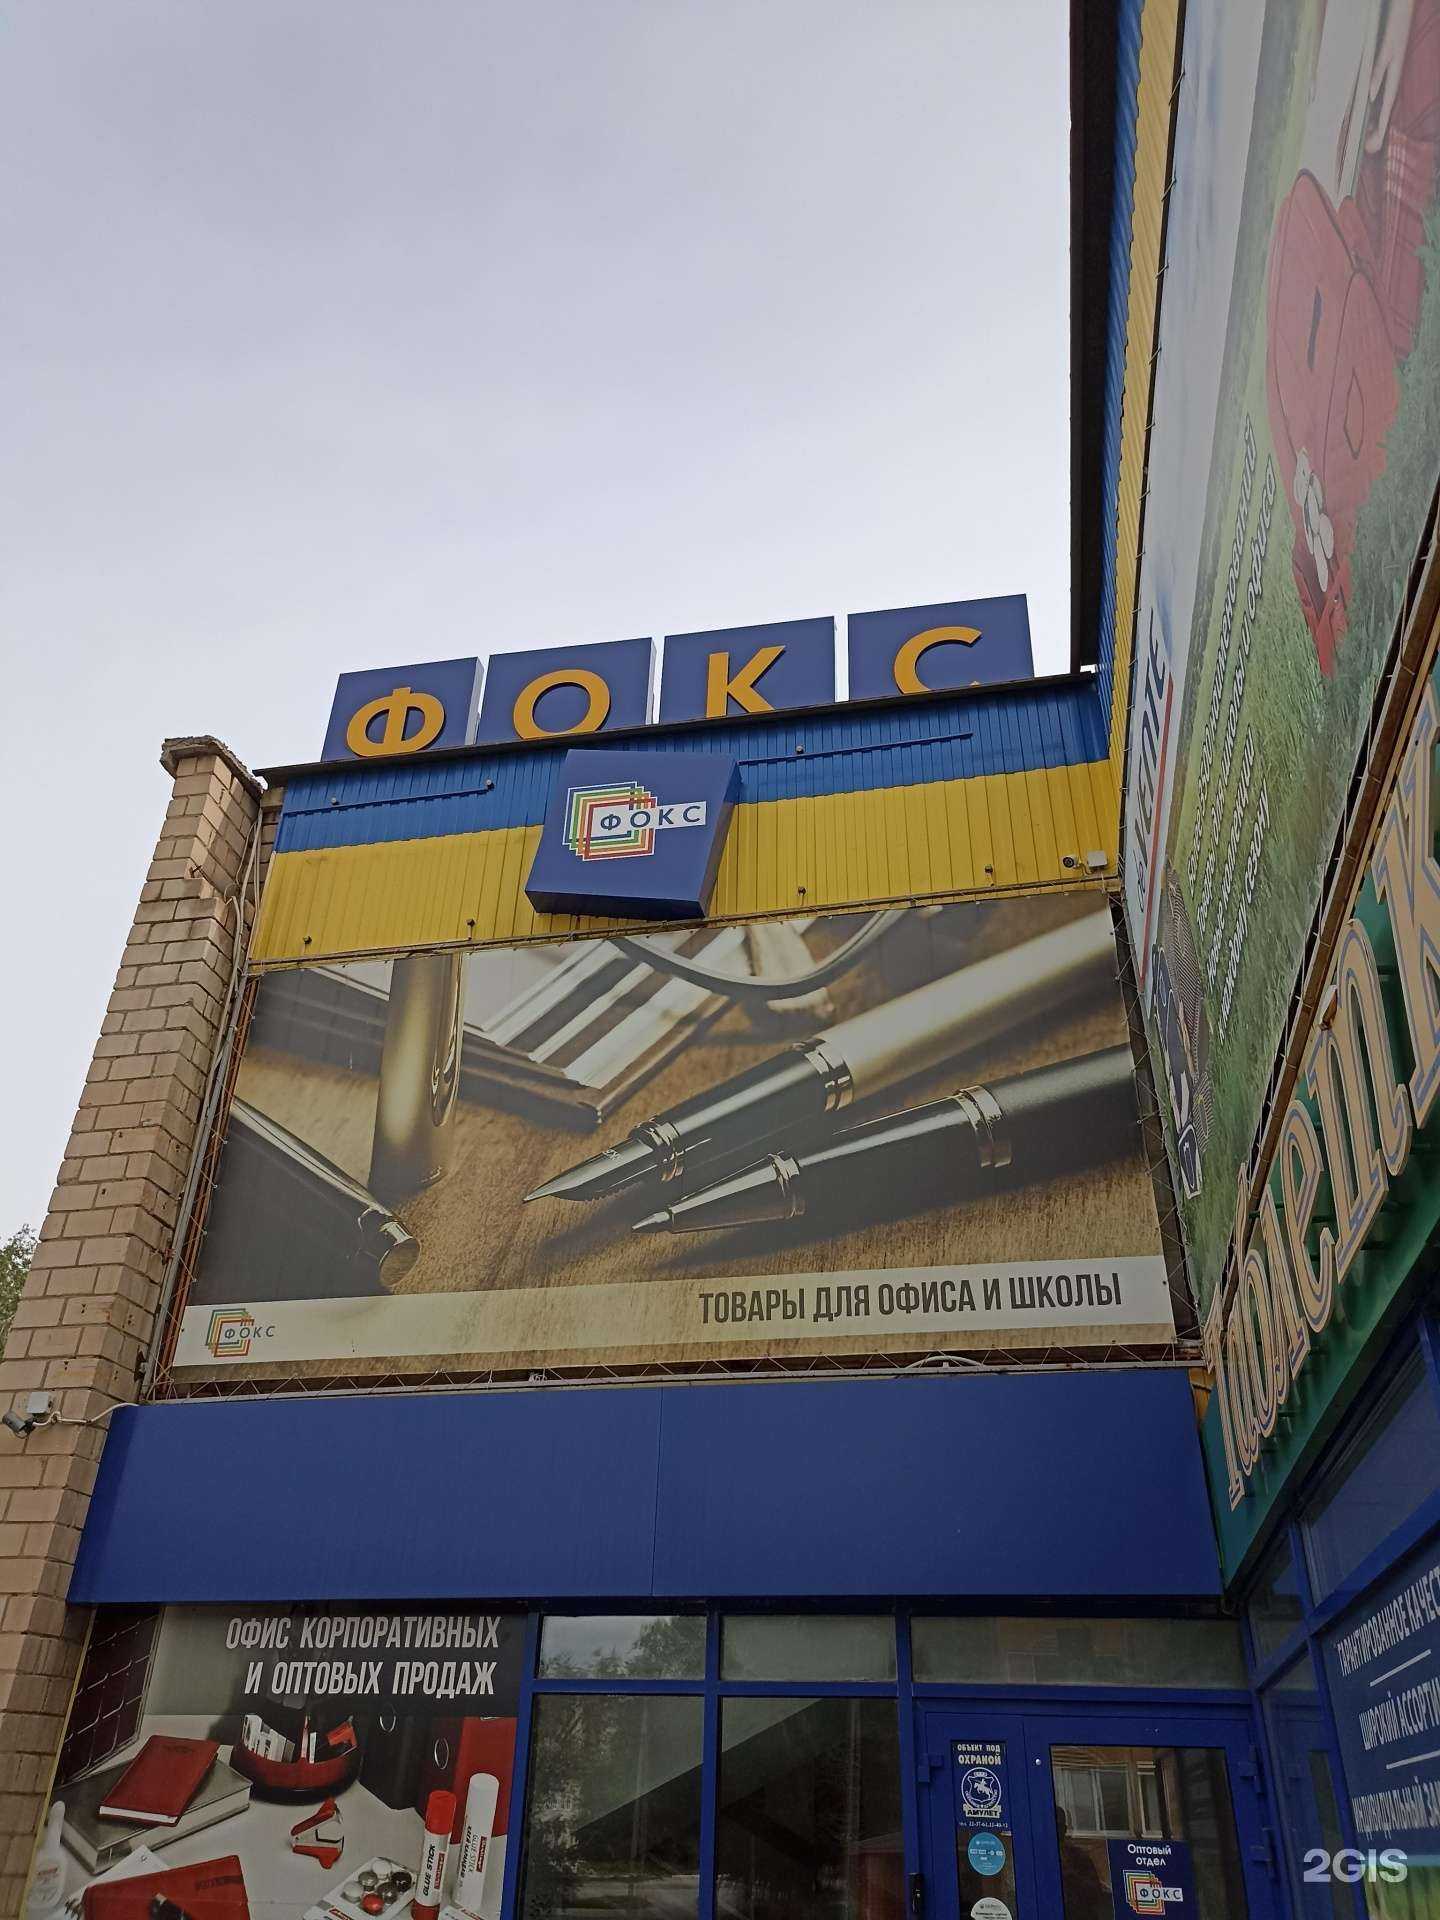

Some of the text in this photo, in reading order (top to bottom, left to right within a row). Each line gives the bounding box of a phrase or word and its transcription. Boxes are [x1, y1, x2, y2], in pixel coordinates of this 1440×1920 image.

[1209, 412, 1257, 743] наименований
[345, 625, 982, 757] ФОКС
[1197, 454, 1276, 942] Товары для школы и офиса
[600, 805, 700, 830] ФОКС
[1207, 723, 1255, 993] Новые коллекции
[1221, 893, 1248, 1030] каждому
[1245, 778, 1270, 904] сезону
[700, 1272, 1122, 1324] ТОВАРЫ ДЛЯ ОФИСА И ШКОЛЫ
[224, 1325, 276, 1339] ФОКС
[226, 1616, 501, 1649] ОФИС КОРПОРАТИВНЫХ
[1337, 1594, 1410, 1677] ГАРАНТИРОВАННОЕ
[245, 1661, 497, 1698] И ОПТОВЫХ ПРОДАЖ
[1358, 1690, 1401, 1750] ШИРОКИЙ
[957, 1743, 1001, 1752] ОБЪЕКТ ПОД
[958, 1752, 1002, 1765] ОХРАНОЙ
[966, 1809, 998, 1817] АМУЛЕТ
[1127, 1844, 1172, 1855] Оптовый
[1135, 1857, 1167, 1867] отдел
[422, 1844, 436, 1897] GLUE STICK
[1140, 1888, 1181, 1900] ФОКС
